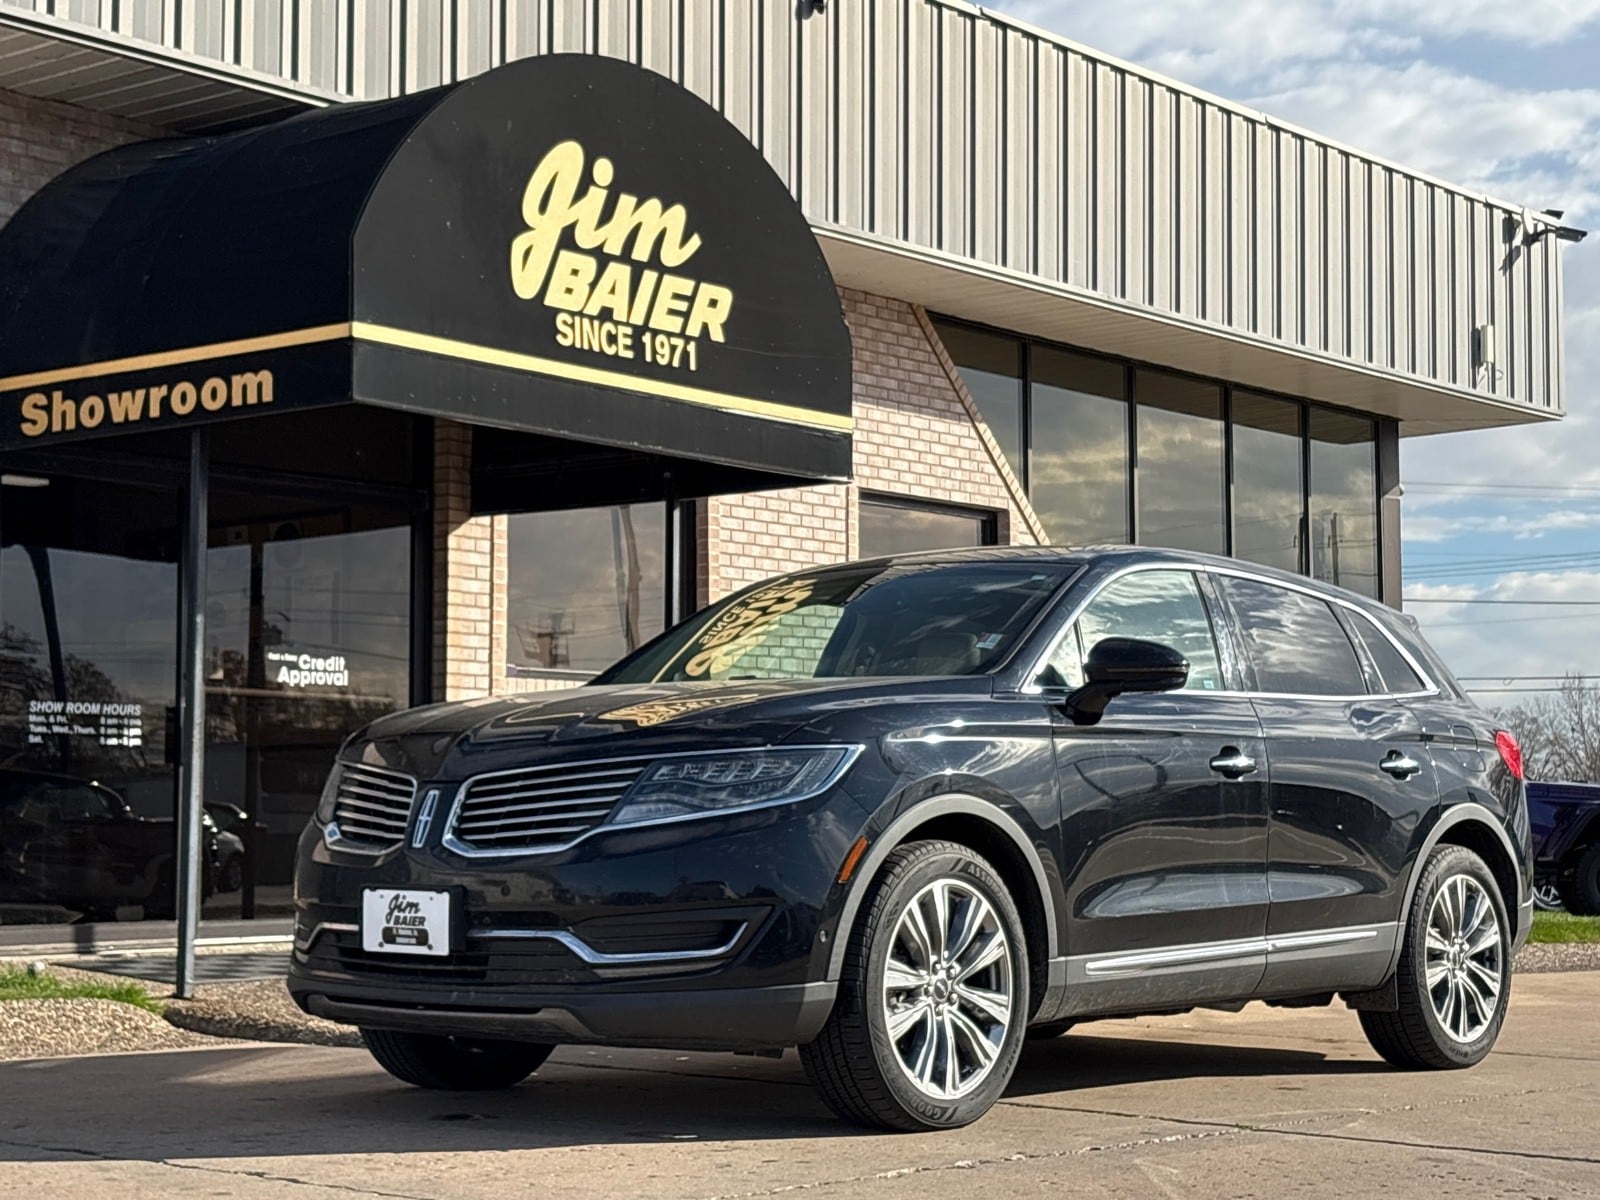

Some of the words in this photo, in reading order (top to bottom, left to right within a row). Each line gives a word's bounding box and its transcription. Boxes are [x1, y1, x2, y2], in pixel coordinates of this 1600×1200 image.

[510, 139, 702, 300] Jim
[543, 249, 733, 343] BAIER
[555, 312, 635, 359] SINCE
[641, 331, 697, 371] 1971
[20, 369, 274, 437] Showroom
[277, 665, 349, 688] Approval
[298, 654, 345, 671] Credit
[29, 700, 64, 713] SHOW
[65, 701, 101, 715] ROOM
[102, 703, 142, 716] HOURS
[385, 893, 421, 925] Jim
[393, 914, 426, 927] BAIER
